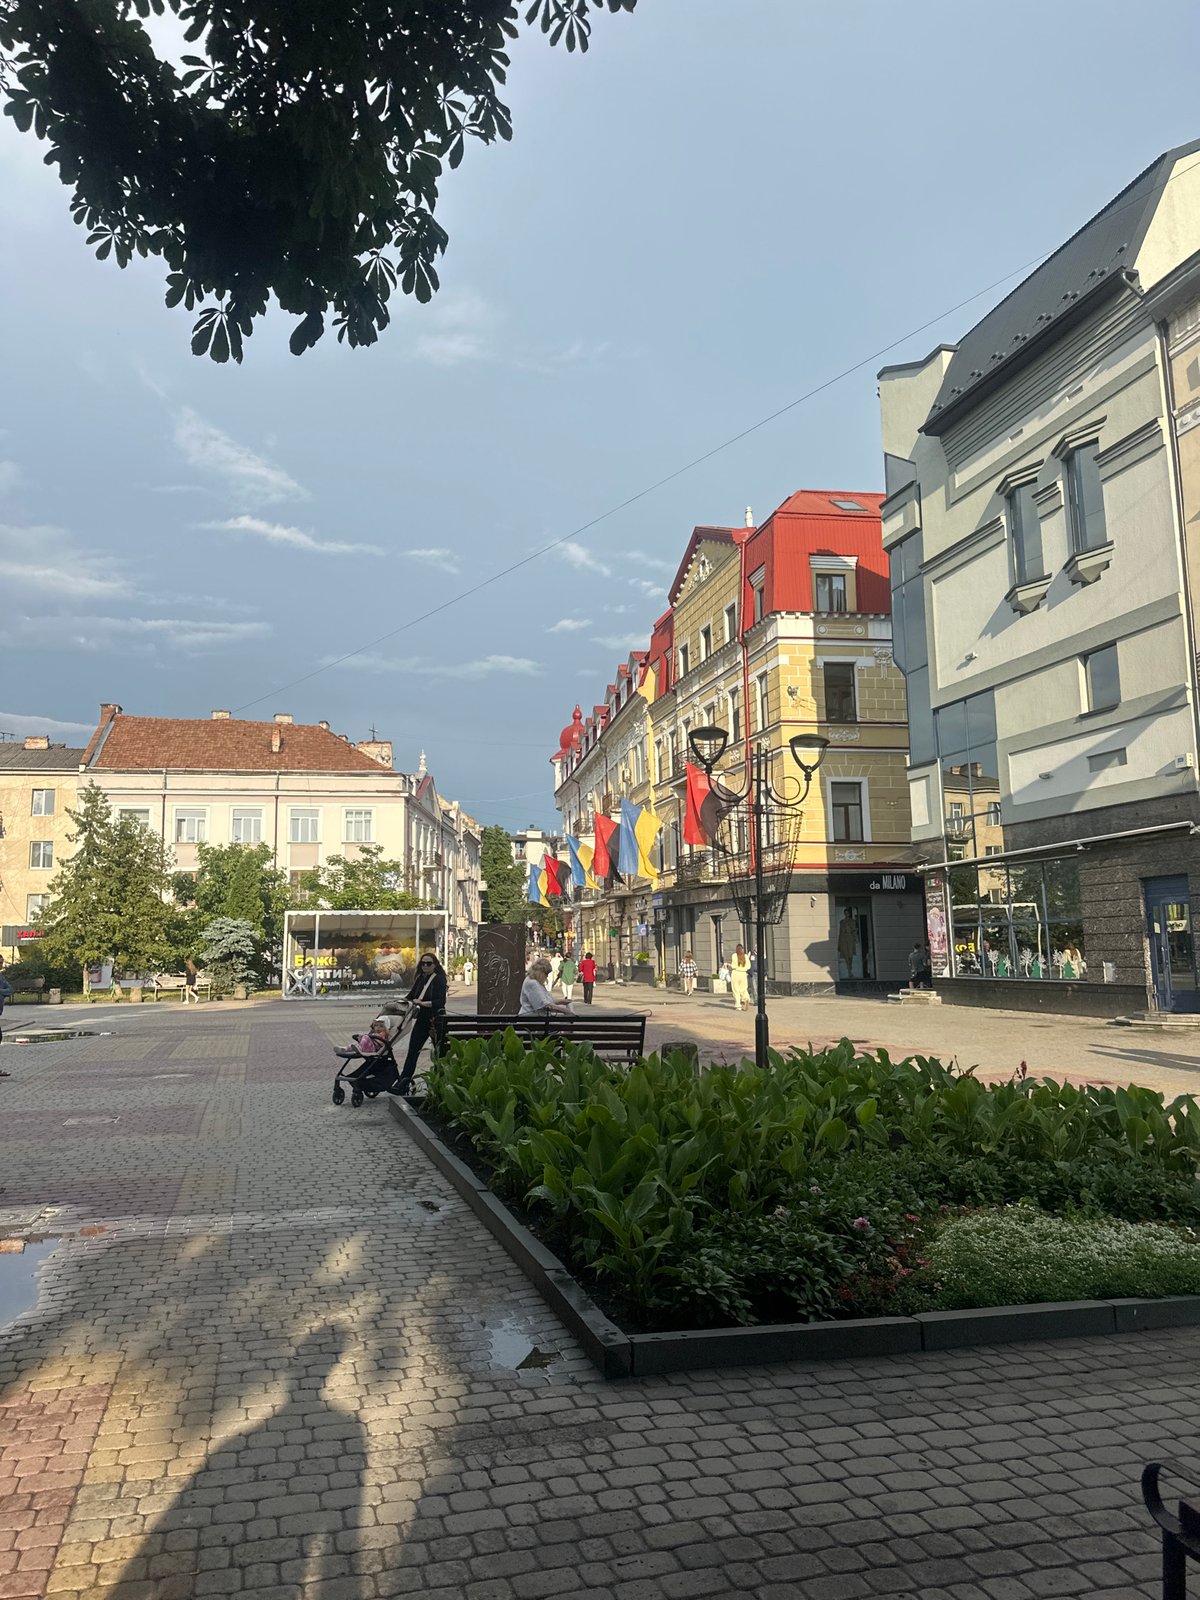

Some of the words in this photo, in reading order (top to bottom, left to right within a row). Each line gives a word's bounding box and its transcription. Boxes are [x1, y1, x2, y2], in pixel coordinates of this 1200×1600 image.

[869, 880, 880, 890] da
[882, 874, 906, 890] MILANO
[294, 954, 338, 967] Боже
[294, 966, 356, 980] Сятий,
